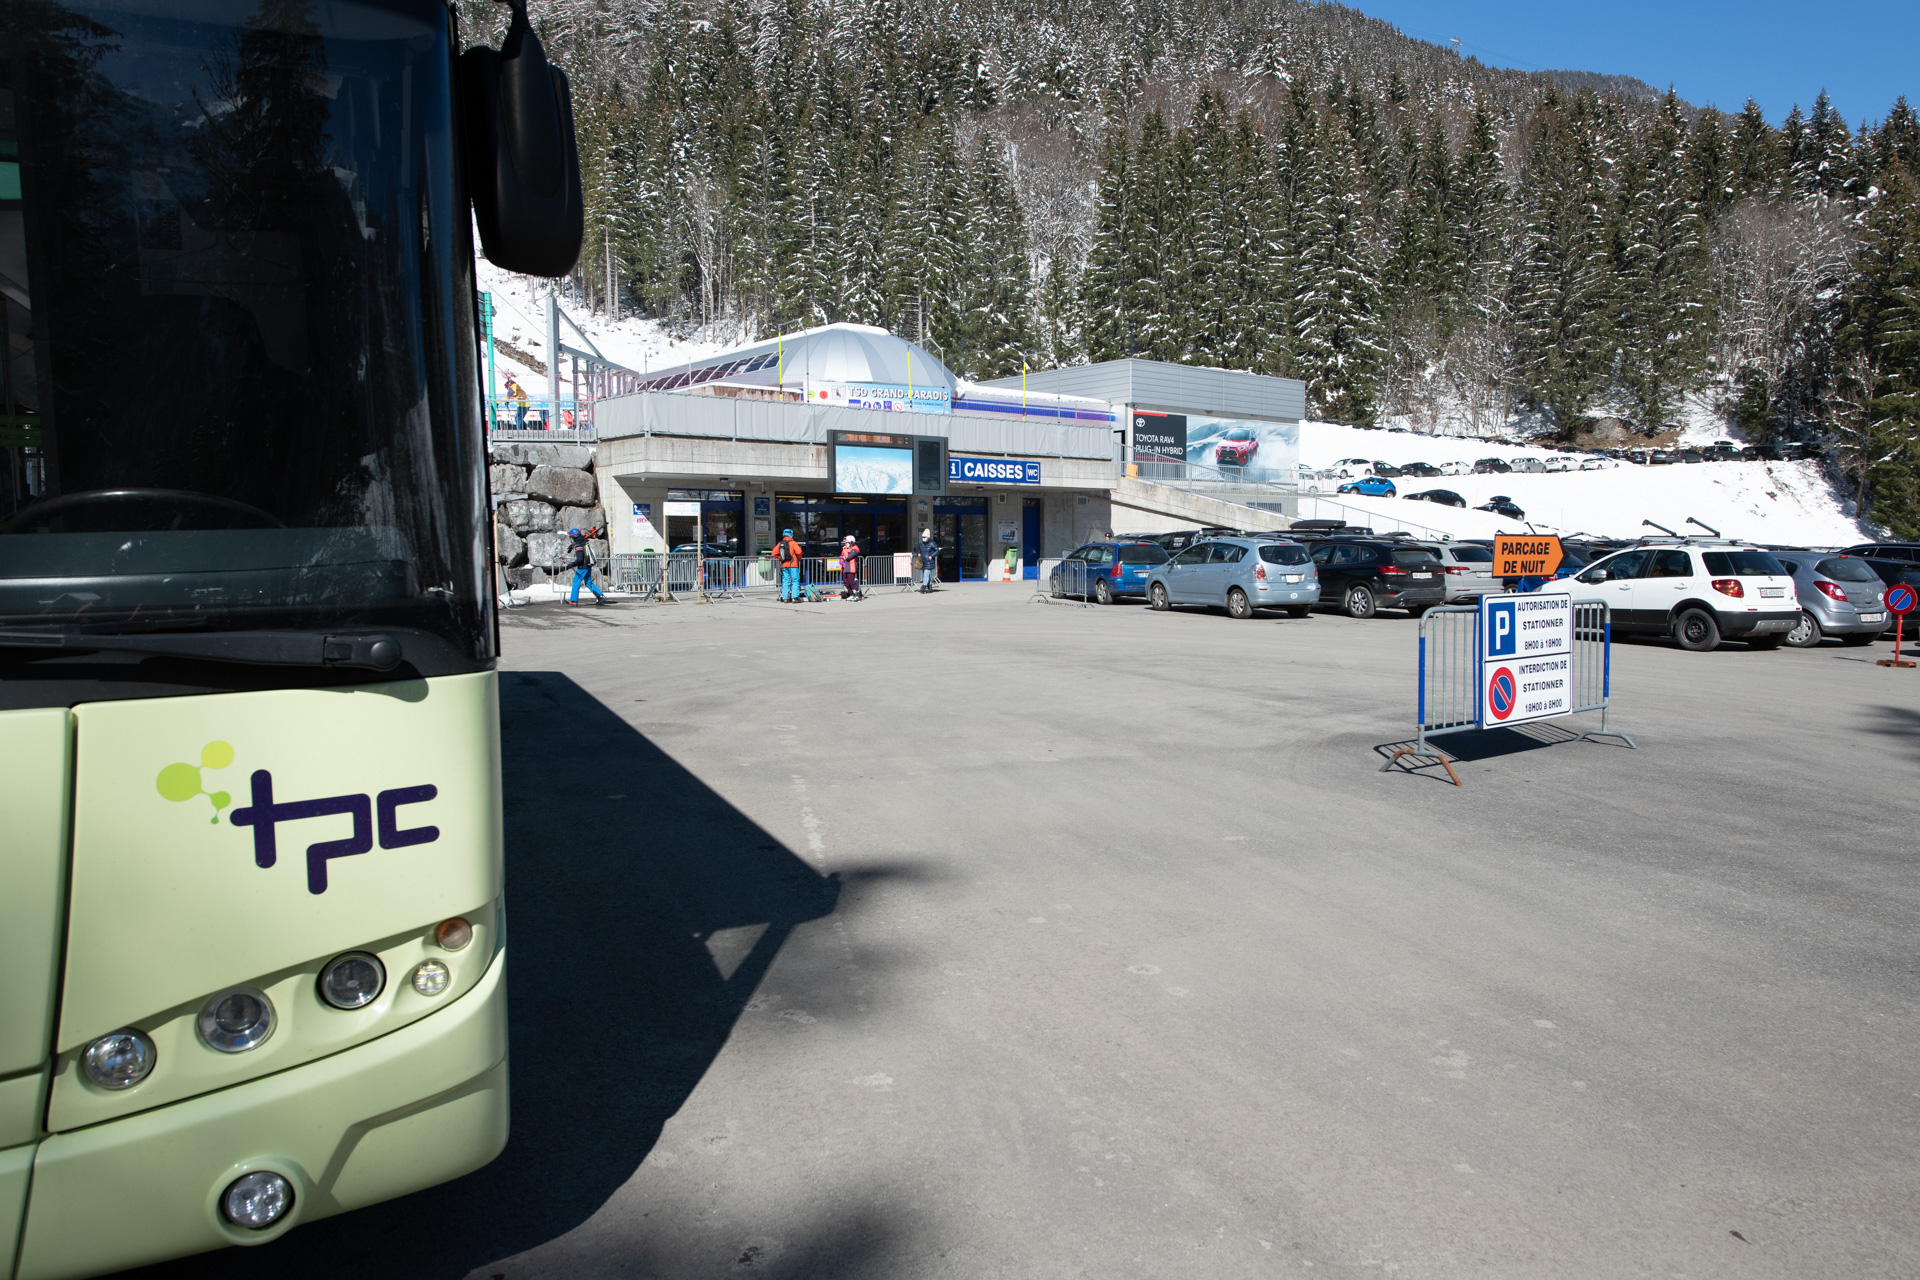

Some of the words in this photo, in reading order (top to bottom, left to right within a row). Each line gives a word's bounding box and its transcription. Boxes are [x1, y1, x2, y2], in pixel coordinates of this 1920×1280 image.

[848, 386, 868, 397] TSD
[870, 387, 949, 401] GRAND-PARADIS
[1135, 434, 1159, 443] TOYOTA
[1160, 435, 1175, 444] RAV4
[1135, 445, 1160, 454] PLUG-IN
[1162, 446, 1184, 455] HYBRID
[963, 462, 1023, 480] CAISSES
[1027, 469, 1038, 477] WC
[1501, 542, 1550, 555] PARCAGE
[1503, 560, 1518, 573] DE
[1520, 560, 1546, 573] NUIT
[1517, 600, 1560, 612] AUTORISATION
[1560, 599, 1568, 609] DE
[1495, 610, 1510, 650] P
[1522, 618, 1564, 631] STATIONNER
[1524, 640, 1539, 650] 8H00
[1540, 638, 1544, 648] à
[1545, 638, 1562, 648] 18H00
[1518, 660, 1559, 675] INTERDICTION
[1560, 659, 1568, 669] DE
[1522, 679, 1564, 693] STATIONNER
[1525, 702, 1542, 713] 18H00
[1543, 700, 1547, 710] à
[1548, 698, 1563, 709] 8H00
[229, 768, 441, 895] tpc
